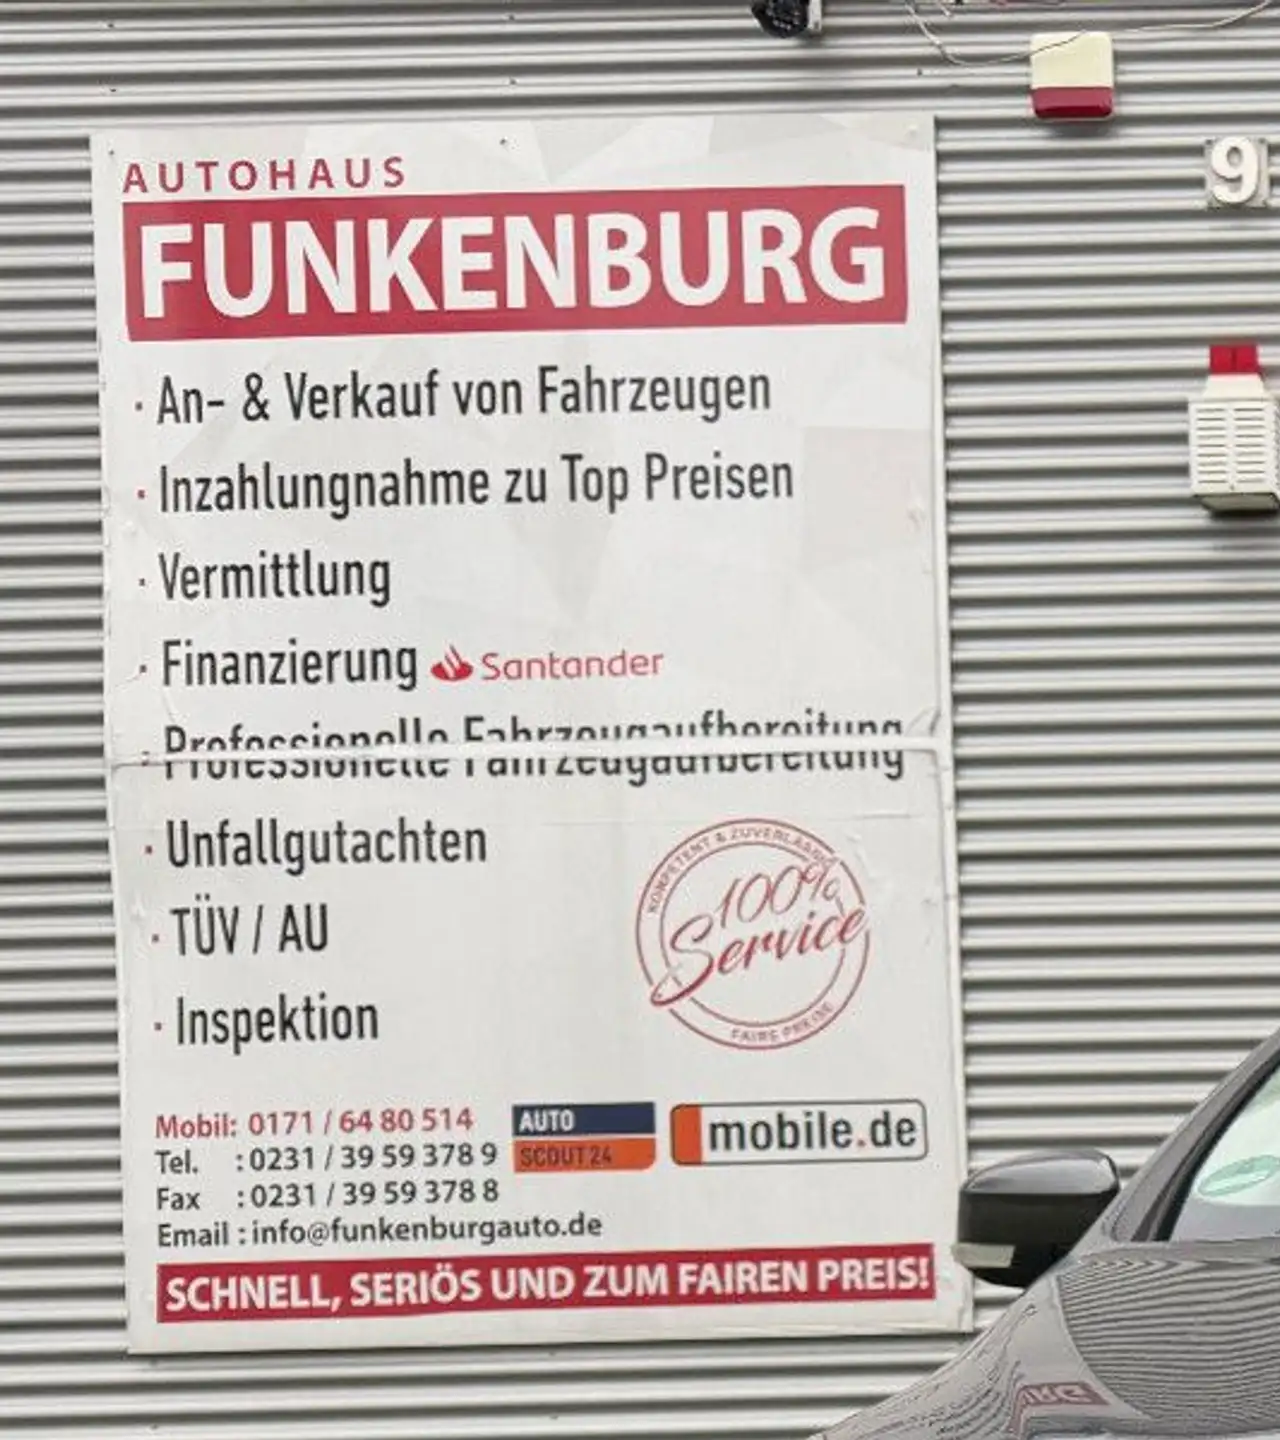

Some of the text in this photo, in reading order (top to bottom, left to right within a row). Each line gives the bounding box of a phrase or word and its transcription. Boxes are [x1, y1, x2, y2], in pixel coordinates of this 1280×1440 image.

[122, 156, 406, 194] AUTOHAUS
[1211, 137, 1259, 204] 9
[139, 206, 885, 320] FUNKENBURG
[157, 365, 772, 425] An- & Verkauf von Fahrzeugen
[159, 451, 795, 519] Inzahlungnahme zu Top Preisen
[158, 549, 391, 607] Vermittlung
[161, 640, 418, 692] Finanzierung
[480, 648, 664, 680] Santander
[164, 707, 905, 788] Professionelle Fahrzeugaufbereitung
[166, 817, 488, 876] Unfallgutachten
[171, 894, 329, 957] TÜV / AU
[714, 864, 841, 929] 100%
[649, 908, 868, 1008] Service
[175, 996, 379, 1055] Inspektion
[154, 1108, 474, 1139] Mobil: 0171 / 64 80 514
[519, 1110, 575, 1131] AUTO
[710, 1111, 917, 1151] mobile.de
[155, 1150, 198, 1174] Tel.
[250, 1147, 315, 1171] 0231
[324, 1145, 332, 1171] /
[341, 1145, 373, 1169] 39
[383, 1145, 415, 1168] 59
[157, 1187, 200, 1211] Fax
[250, 1183, 316, 1208] 0231
[326, 1181, 335, 1207] /
[343, 1181, 375, 1206] 39
[384, 1181, 417, 1205] 59
[158, 1222, 229, 1247] Email
[250, 1212, 603, 1247] info@funkenburgauto.de
[165, 1255, 931, 1315] SCHNELL, SERIÖS UND ZUM FAIREN PREIS!
